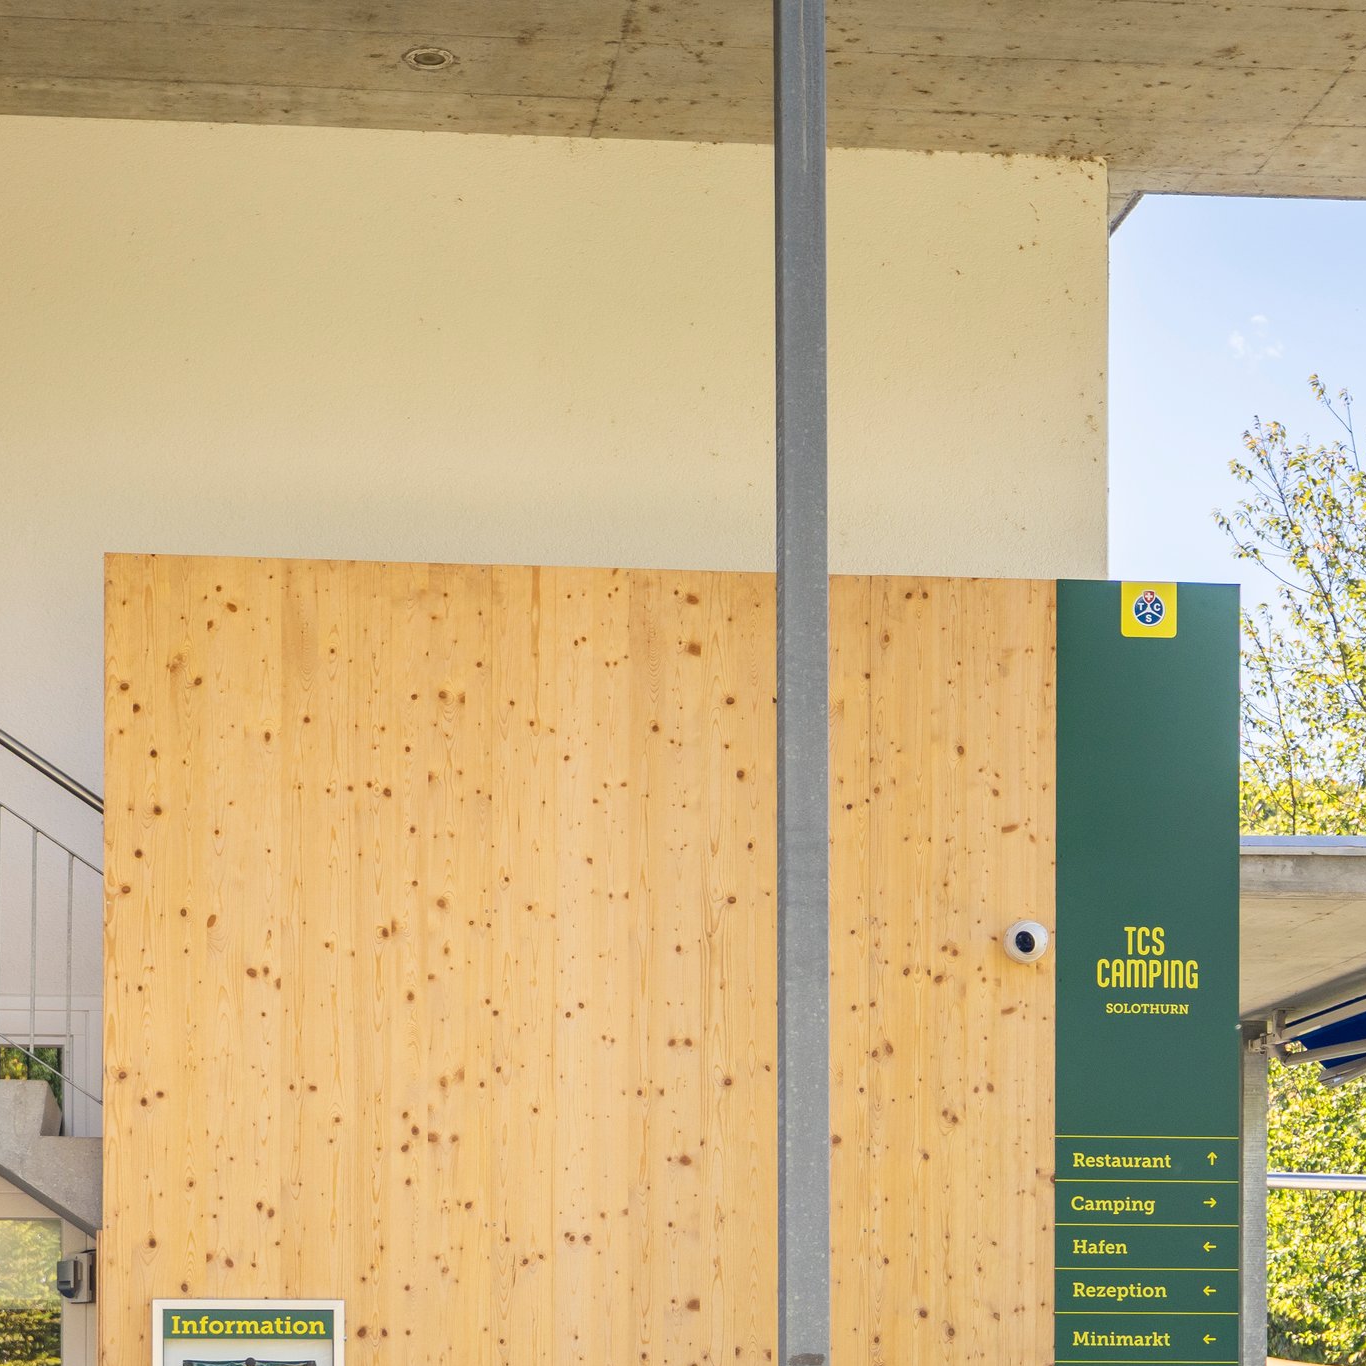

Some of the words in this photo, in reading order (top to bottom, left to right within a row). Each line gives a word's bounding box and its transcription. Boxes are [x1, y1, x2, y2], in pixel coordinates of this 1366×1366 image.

[1123, 926, 1165, 956] TCS
[1096, 958, 1199, 989] CAMPING
[1105, 1002, 1190, 1015] SOLOTHURN
[1072, 1152, 1172, 1169] Restaurant
[1070, 1195, 1156, 1215] Camping
[1072, 1239, 1128, 1255] Hafen
[1072, 1282, 1168, 1302] Rezeption
[170, 1315, 326, 1336] Information
[1072, 1331, 1171, 1348] Minimarkt
